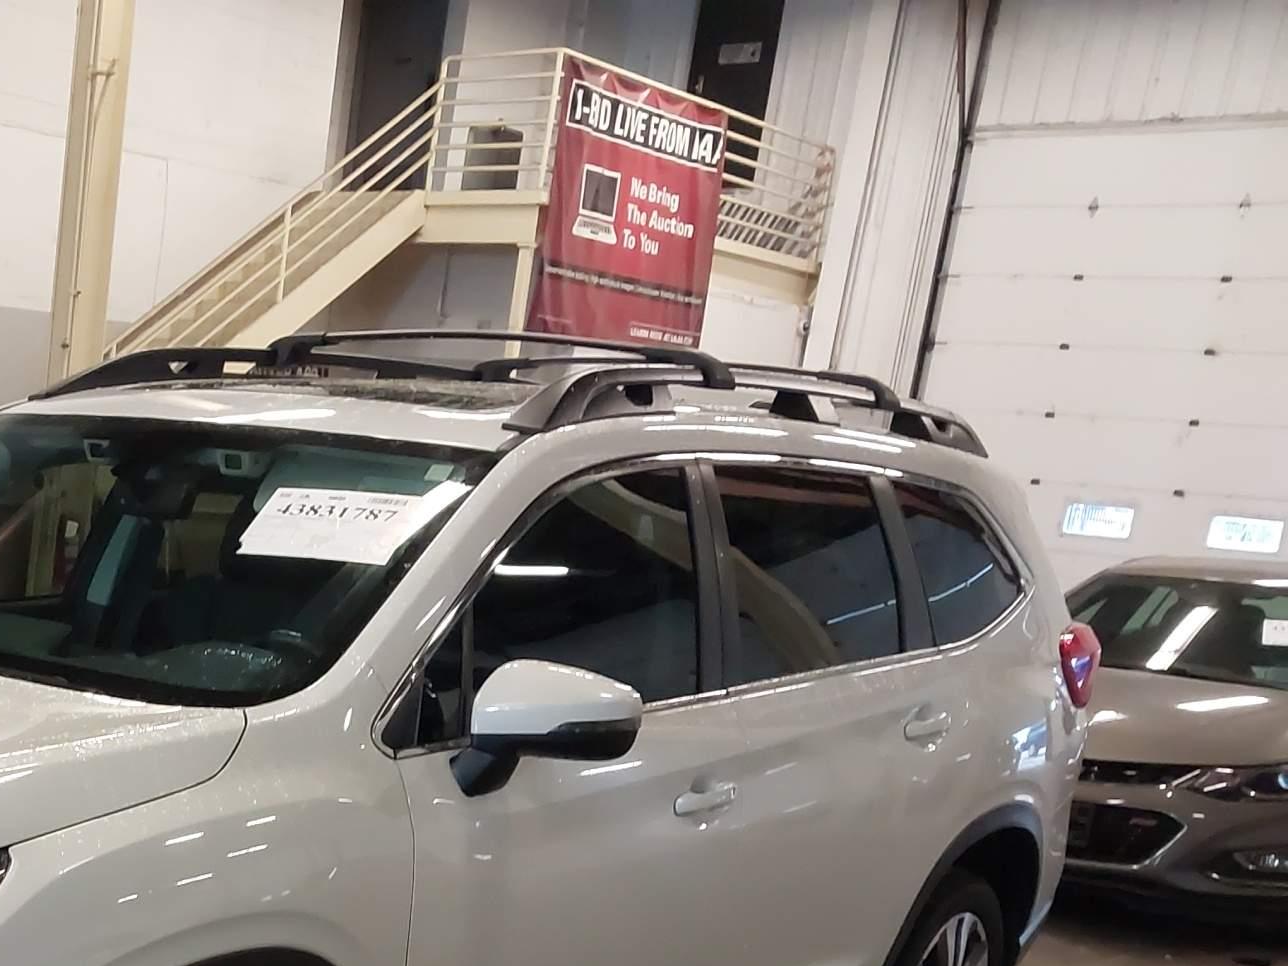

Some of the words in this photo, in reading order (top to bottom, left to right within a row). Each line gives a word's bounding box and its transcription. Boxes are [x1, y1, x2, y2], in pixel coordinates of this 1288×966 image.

[614, 103, 649, 143] LIVE
[648, 116, 691, 157] FROM
[648, 183, 680, 213] Bring
[627, 203, 647, 226] The
[648, 209, 694, 239] Auction
[623, 228, 636, 250] To
[640, 232, 659, 256] You
[277, 502, 398, 522] 43831787
